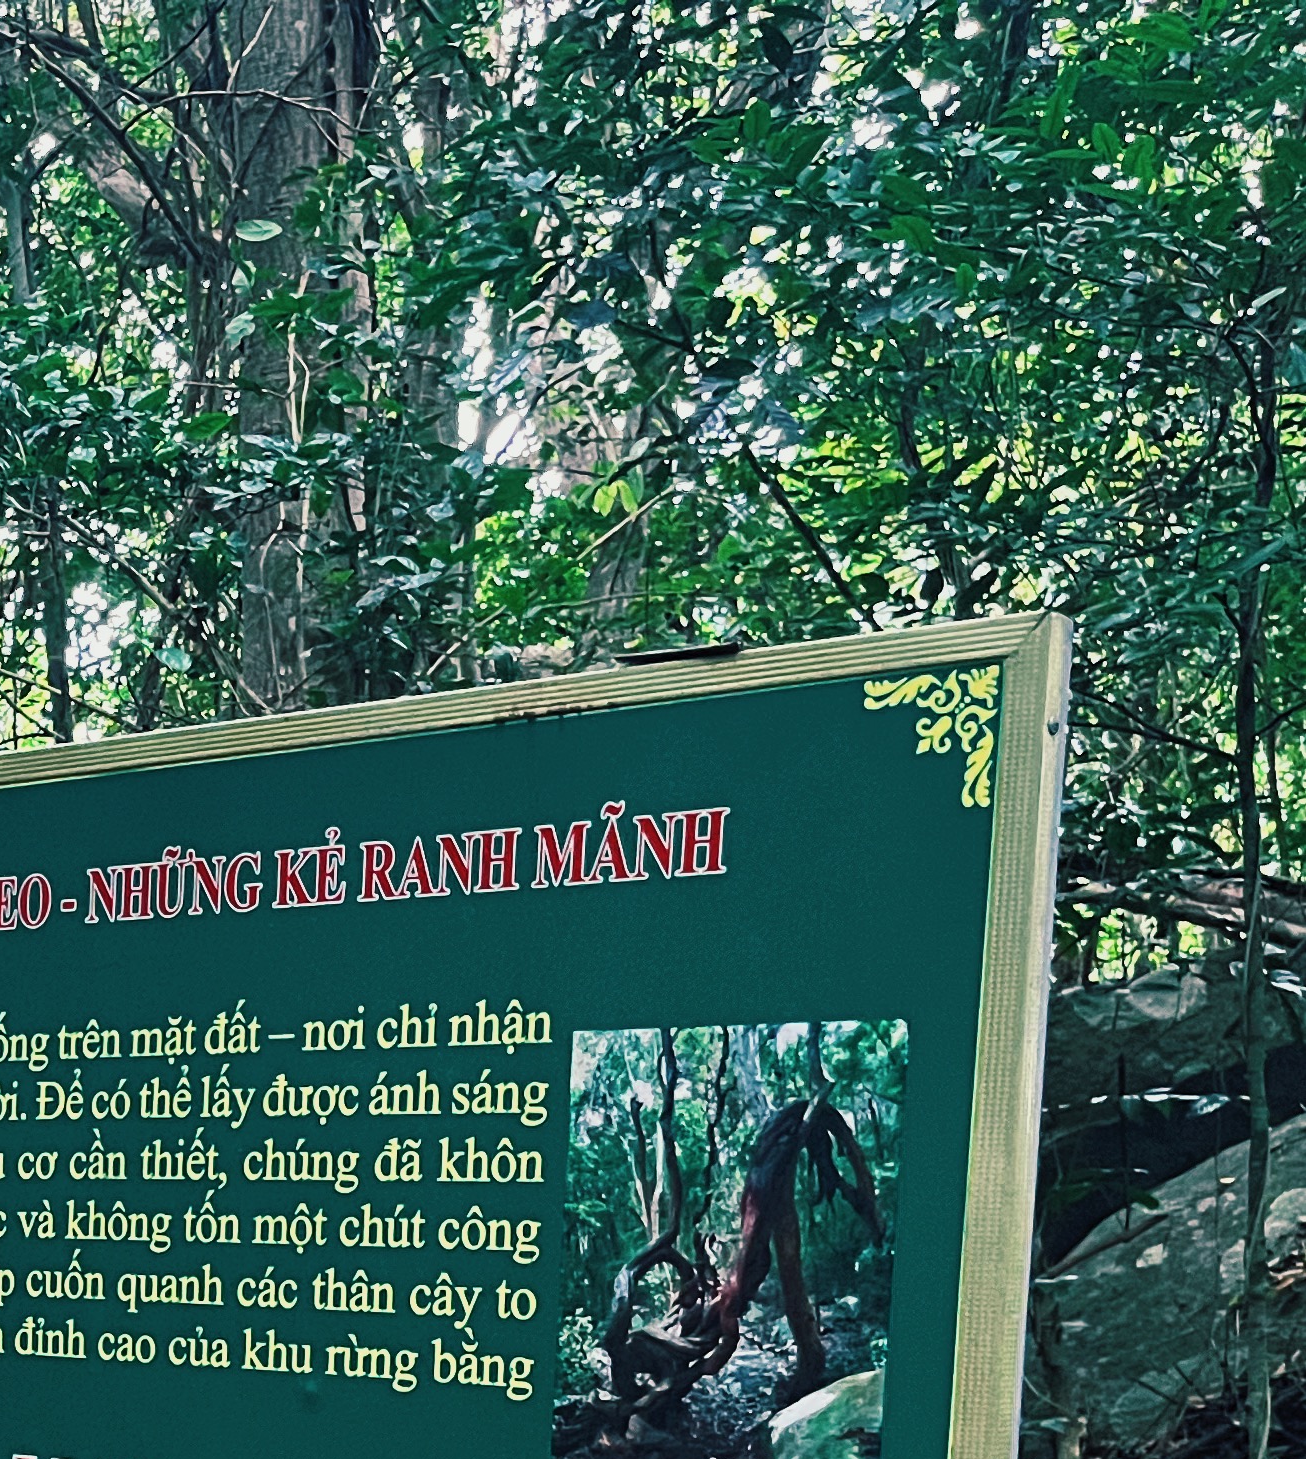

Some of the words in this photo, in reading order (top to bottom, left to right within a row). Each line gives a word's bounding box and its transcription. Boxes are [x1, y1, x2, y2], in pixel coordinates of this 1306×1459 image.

[85, 846, 263, 923] NHỮNG
[272, 827, 346, 908] KẺ
[357, 827, 522, 902] RANH
[531, 800, 730, 888] MÃNH
[58, 1019, 121, 1059] trên
[130, 1016, 196, 1065] mặt
[205, 1000, 261, 1054] đất
[302, 1006, 365, 1050] nơi
[377, 1003, 437, 1048] chỉ
[448, 999, 552, 1054] nhận
[36, 1069, 83, 1119] Để
[92, 1079, 130, 1119] có
[140, 1065, 191, 1118] thể
[196, 1064, 255, 1129] lấy
[263, 1074, 358, 1125] được
[369, 1070, 441, 1115] ánh
[452, 1069, 549, 1126] sáng
[18, 1152, 58, 1179] cơ
[70, 1129, 126, 1179] cần
[141, 1127, 227, 1189] thiết,
[244, 1138, 359, 1193] chúng
[375, 1138, 422, 1181] đã
[437, 1137, 544, 1182] khôn
[18, 1200, 55, 1238] và
[65, 1200, 171, 1253] không
[184, 1190, 240, 1243] tốn
[252, 1203, 327, 1253] một
[340, 1204, 425, 1248] chút
[439, 1206, 541, 1264] công
[26, 1249, 105, 1299] cuốn
[118, 1264, 223, 1313] quanh
[238, 1267, 297, 1308] các
[313, 1268, 395, 1313] thân
[410, 1273, 482, 1329] cây
[496, 1280, 536, 1320] to
[15, 1317, 86, 1358] đỉnh
[98, 1333, 155, 1363] cao
[169, 1327, 230, 1367] của
[242, 1328, 312, 1373] khu
[325, 1334, 418, 1392] rừng
[432, 1327, 534, 1400] bằng
